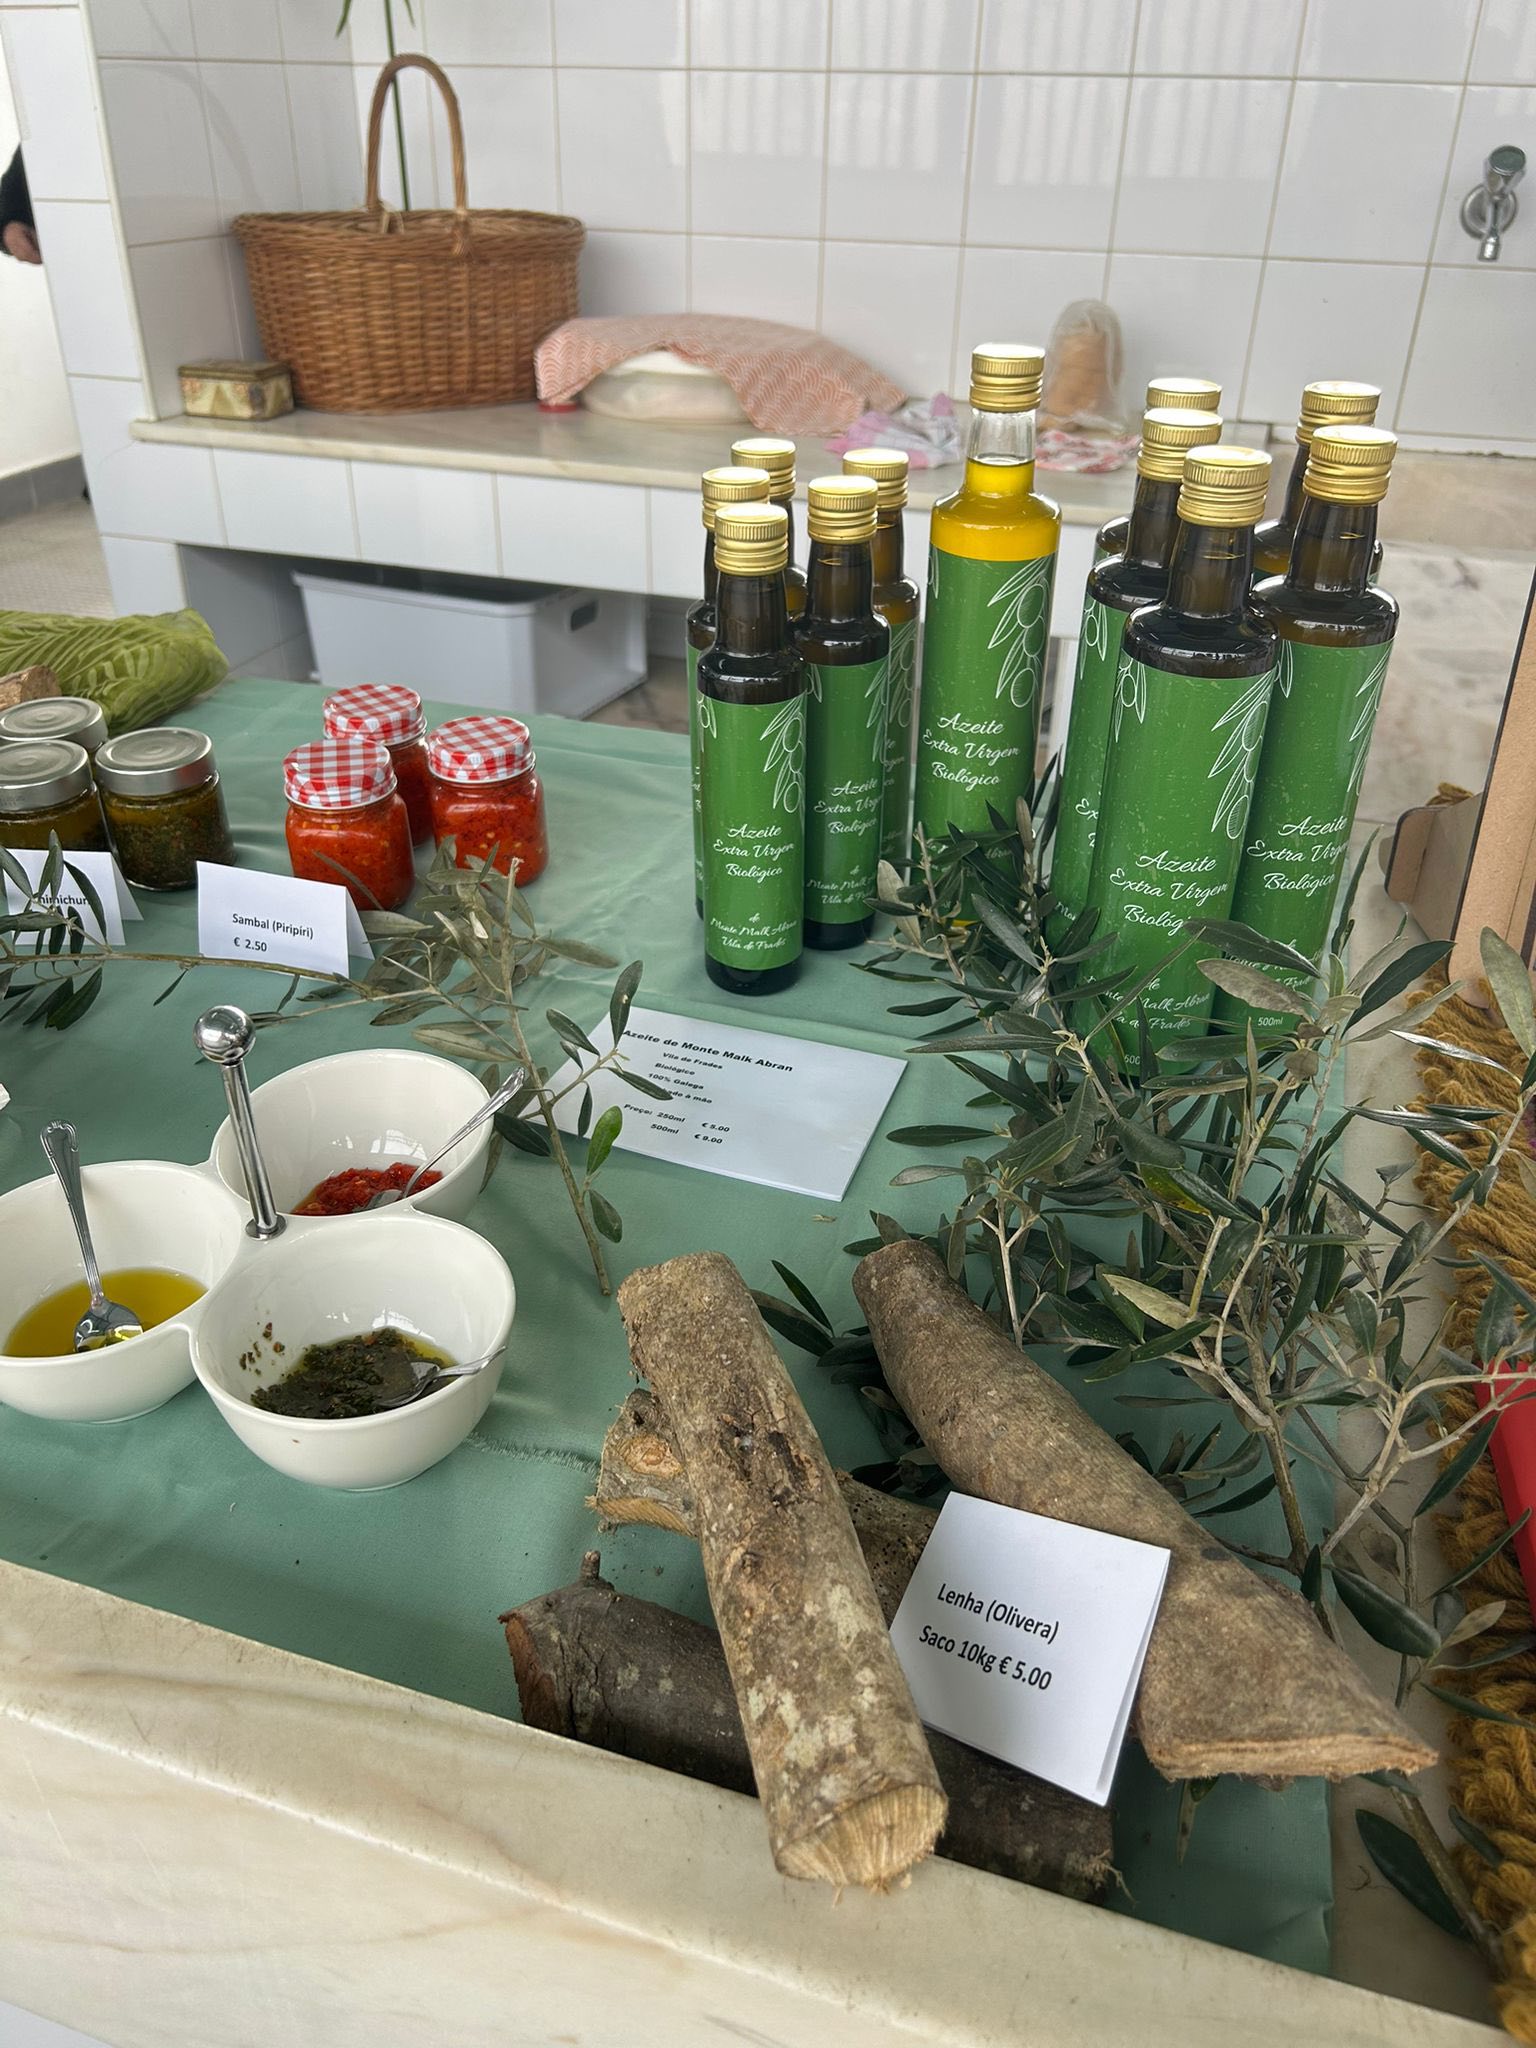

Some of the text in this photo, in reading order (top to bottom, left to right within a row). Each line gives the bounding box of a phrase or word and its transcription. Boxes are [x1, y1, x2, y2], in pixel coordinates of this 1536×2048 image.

[937, 712, 1005, 735] Azeite
[922, 729, 960, 756] Extra
[964, 742, 1020, 767] Virgem
[931, 761, 1002, 792] Biológico
[813, 800, 852, 816] Extra
[727, 823, 783, 839] Azeite
[1278, 815, 1347, 836] Azeite
[713, 838, 751, 858] Extra
[1246, 839, 1306, 862] Extra
[1135, 850, 1217, 874] Azeite
[725, 863, 783, 884] Biológico
[806, 879, 839, 891] Monte
[1109, 867, 1229, 907] Extra Virgem
[1263, 872, 1335, 898] Biológico
[232, 913, 270, 930] Sambal
[710, 917, 738, 934] Monte
[738, 926, 770, 937] Malk
[1123, 904, 1192, 937] Biológ
[233, 936, 268, 952] € 2.50
[721, 936, 786, 951] Vila de Frades
[1257, 1017, 1284, 1027] 500ml
[623, 1030, 793, 1072] Azeite de Monte Malk Abran
[662, 1052, 679, 1060] Vila
[693, 1059, 724, 1070] Frades
[655, 1062, 696, 1076] Biológico
[648, 1073, 704, 1090] 100% Galega
[693, 1095, 713, 1104] mão
[624, 1103, 653, 1115] Preço:
[657, 1111, 686, 1123] 250ml
[709, 1123, 730, 1133] 5.00
[650, 1123, 680, 1135] 500ml
[702, 1135, 724, 1145] 9.00
[937, 1583, 1059, 1645] Lenha (Olivera)
[919, 1625, 1052, 1690] Saco 10kg € 5.00
